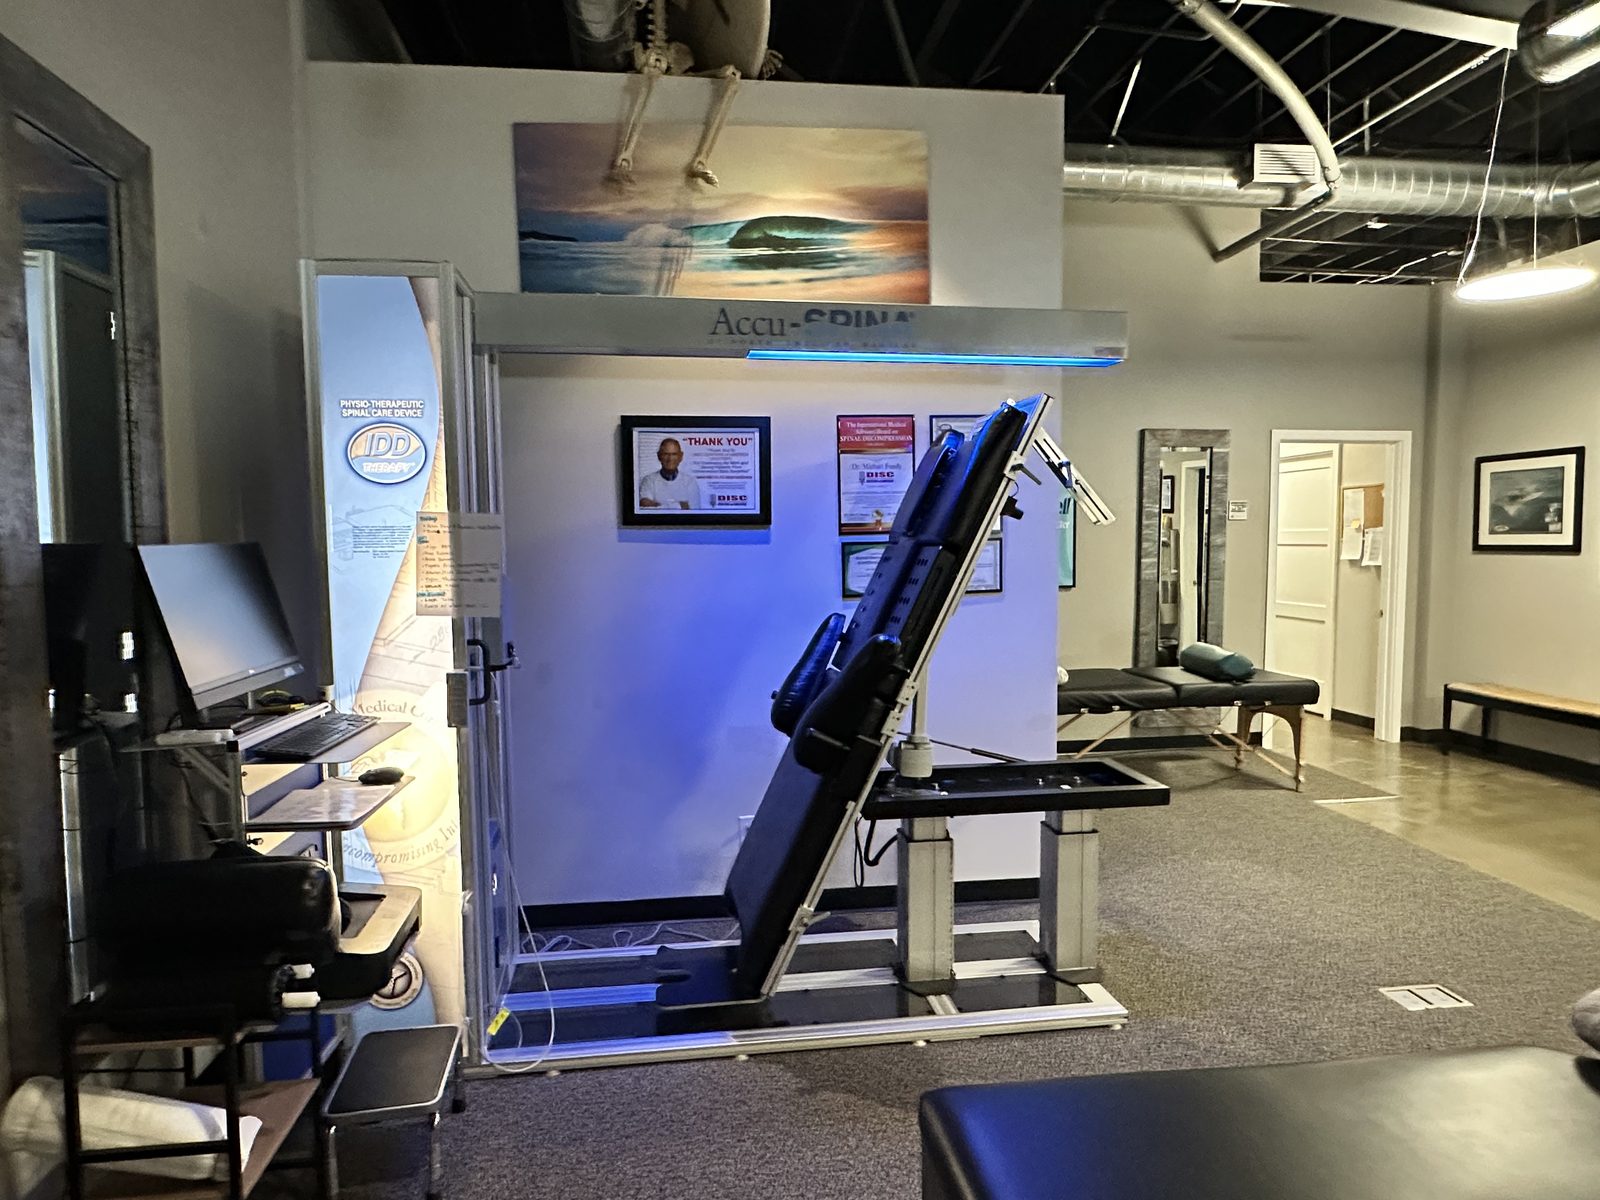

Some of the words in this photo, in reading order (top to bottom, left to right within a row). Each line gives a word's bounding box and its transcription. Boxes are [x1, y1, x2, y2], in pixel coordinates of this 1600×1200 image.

[340, 399, 425, 408] PHYSIO-THERAPEUTIC
[342, 408, 371, 417] SPINAL
[371, 409, 393, 417] CARE
[394, 409, 423, 417] DEVICE
[363, 431, 411, 457] IDD
[350, 699, 408, 714] Medical
[343, 838, 444, 868] ncompromising
